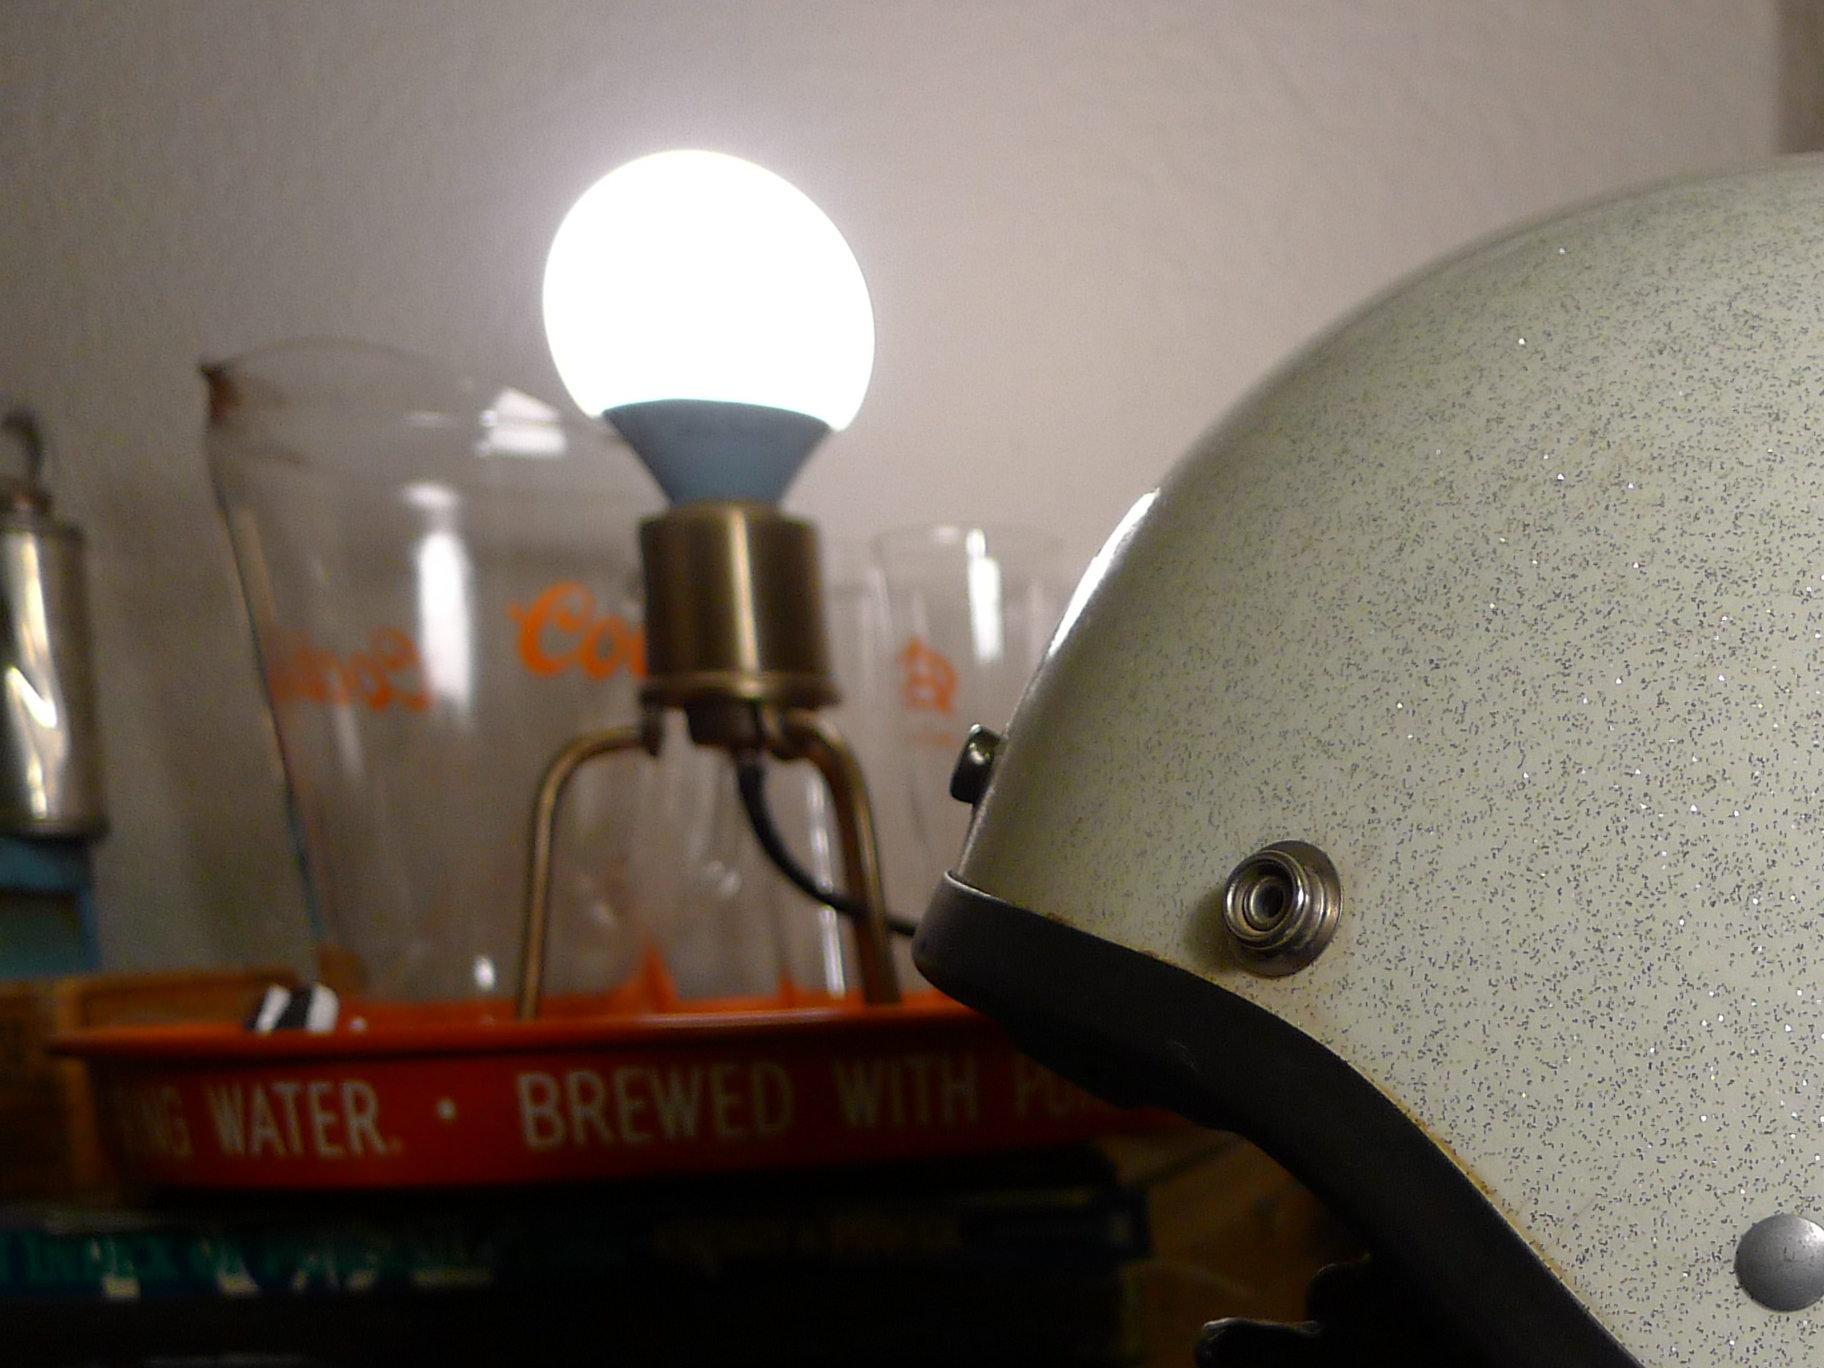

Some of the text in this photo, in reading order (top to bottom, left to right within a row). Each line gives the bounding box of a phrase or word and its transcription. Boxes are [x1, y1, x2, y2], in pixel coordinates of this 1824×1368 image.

[204, 1078, 404, 1160] WATER.
[516, 1061, 796, 1150] BREWED
[832, 1051, 981, 1130] WITH
